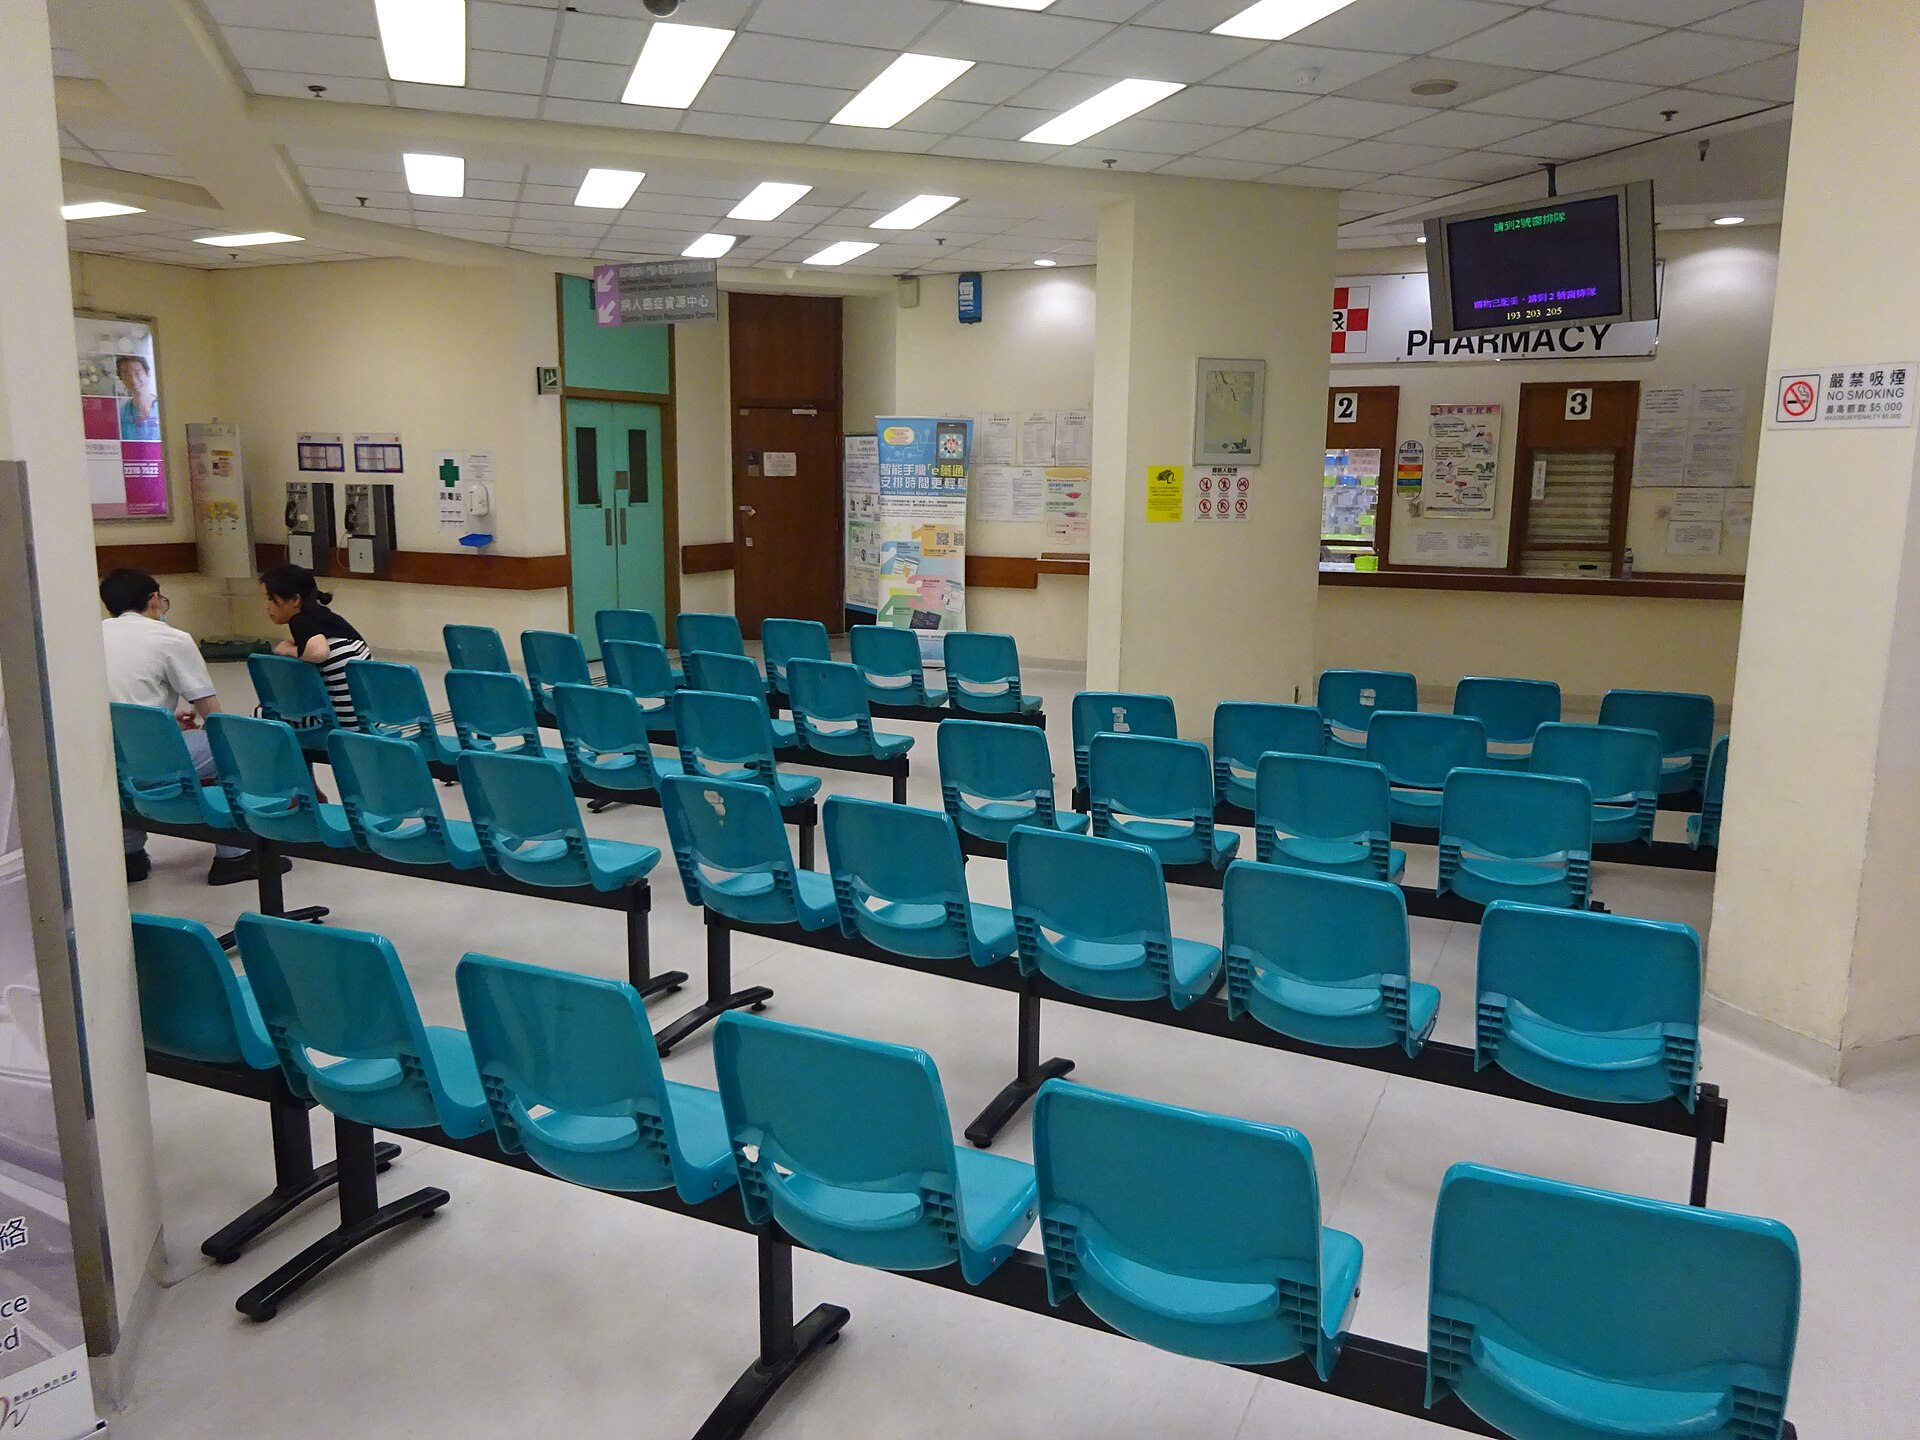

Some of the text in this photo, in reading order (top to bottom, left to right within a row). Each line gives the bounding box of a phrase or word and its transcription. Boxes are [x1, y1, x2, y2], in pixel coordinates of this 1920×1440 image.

[1506, 306, 1562, 320] 193 203 205
[1407, 323, 1612, 356] PHARMACY
[1829, 369, 1906, 388] 嚴禁吸煙
[1569, 392, 1588, 416] 3
[1826, 388, 1904, 401] NO SMOKING
[1338, 396, 1353, 419] 2
[1869, 401, 1903, 412] $5,000
